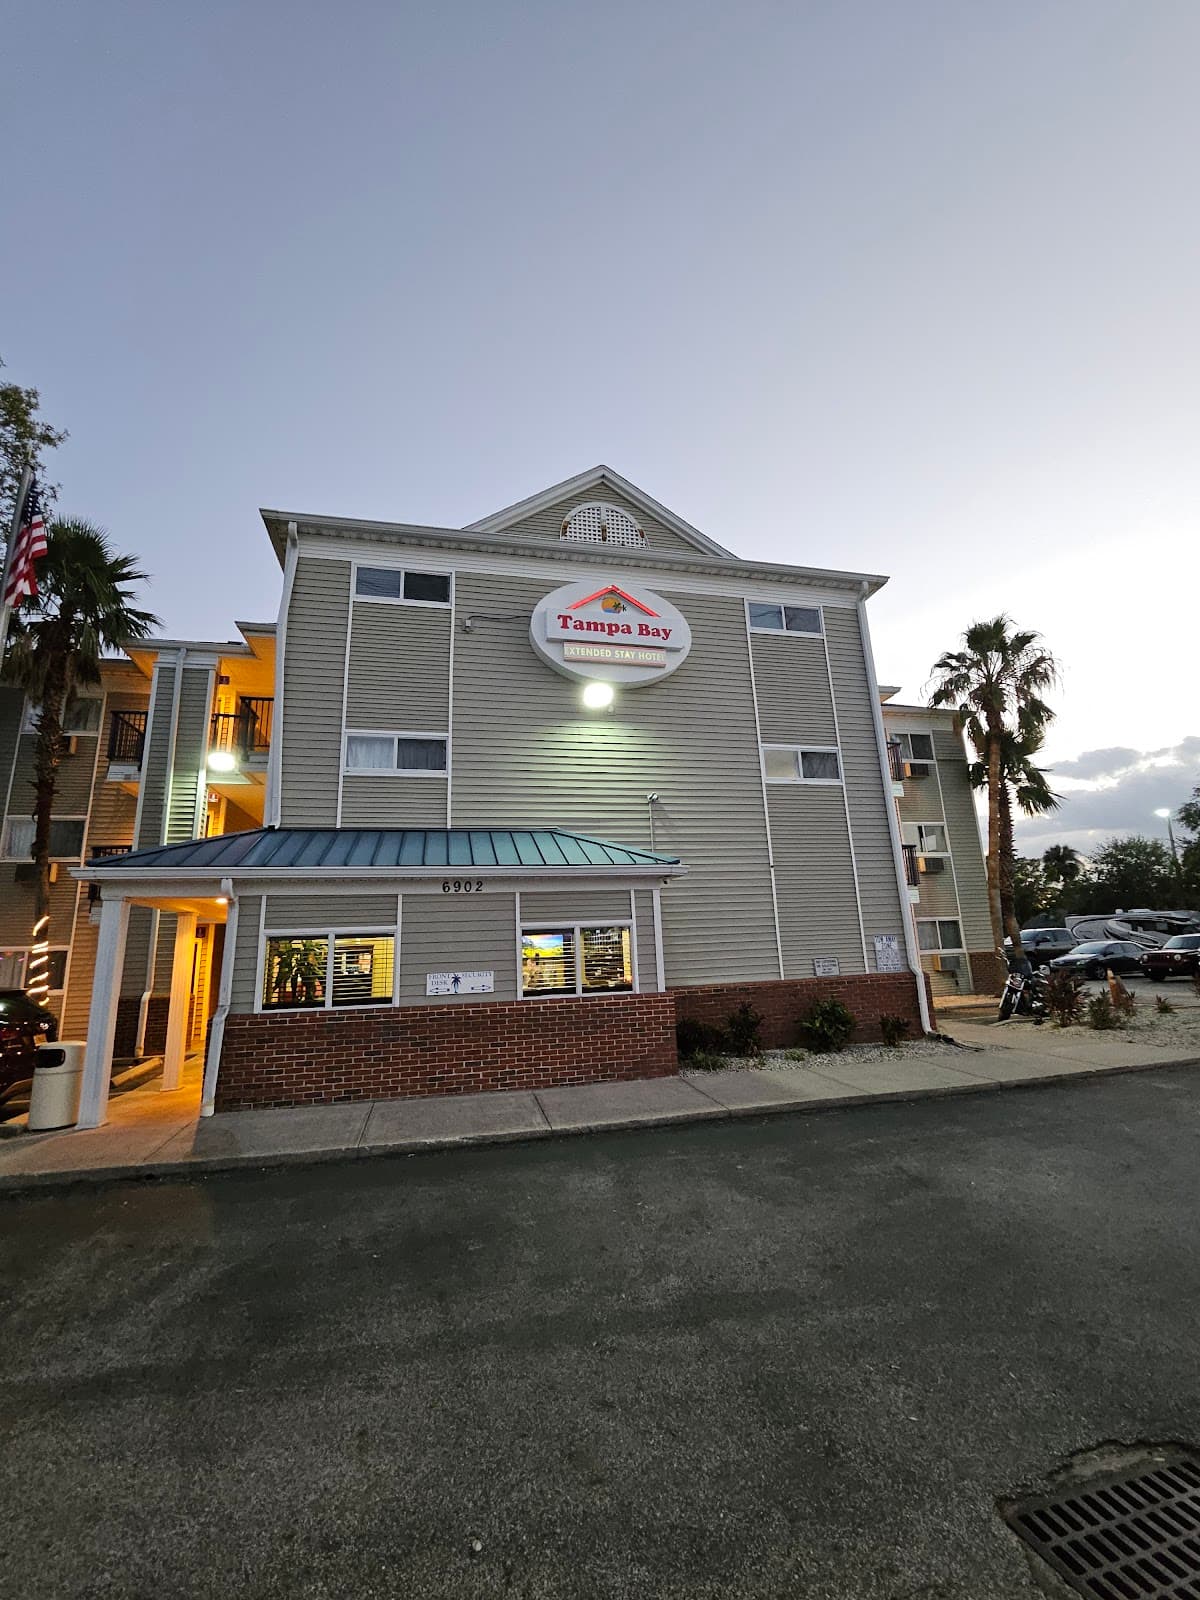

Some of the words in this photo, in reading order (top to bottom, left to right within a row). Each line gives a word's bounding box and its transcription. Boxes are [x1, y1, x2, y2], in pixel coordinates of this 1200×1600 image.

[557, 614, 632, 636] Tampa
[637, 623, 672, 640] Bay
[564, 646, 611, 657] EXTENDED
[614, 650, 635, 659] STAY
[638, 652, 665, 661] HOTEL
[442, 880, 483, 893] 6902
